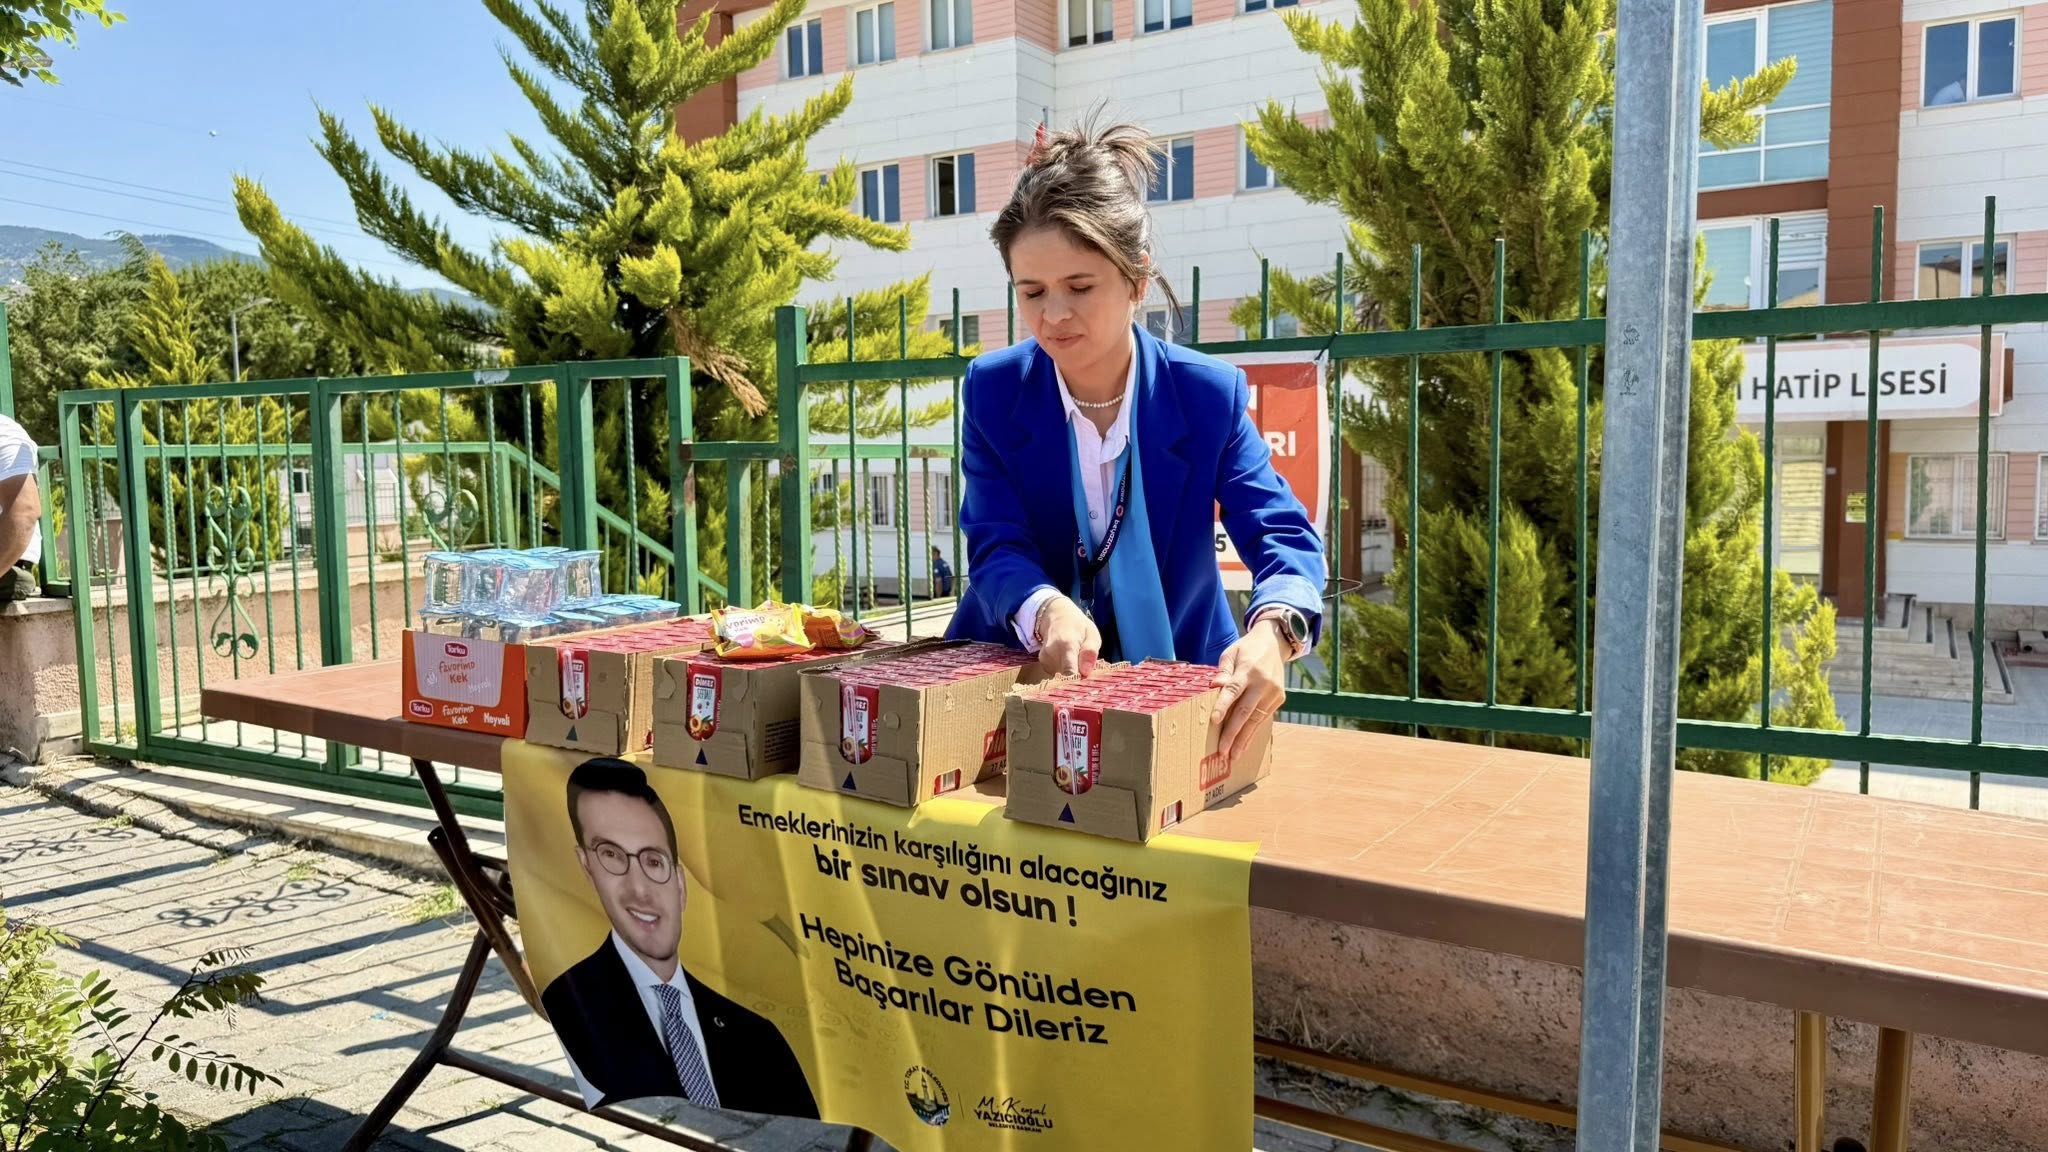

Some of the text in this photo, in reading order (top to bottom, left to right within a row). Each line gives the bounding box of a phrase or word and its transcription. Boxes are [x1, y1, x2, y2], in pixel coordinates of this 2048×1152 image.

[1753, 368, 1841, 400] HATİP
[1851, 362, 1947, 397] LSESİ
[738, 804, 1168, 903] Emeklerinizin karşılığını alacağınız
[813, 844, 1077, 927] bir sınav olsun !
[799, 912, 1137, 1012] Hepinize Gönülden
[834, 957, 1109, 1045] Başarılar Dileriz
